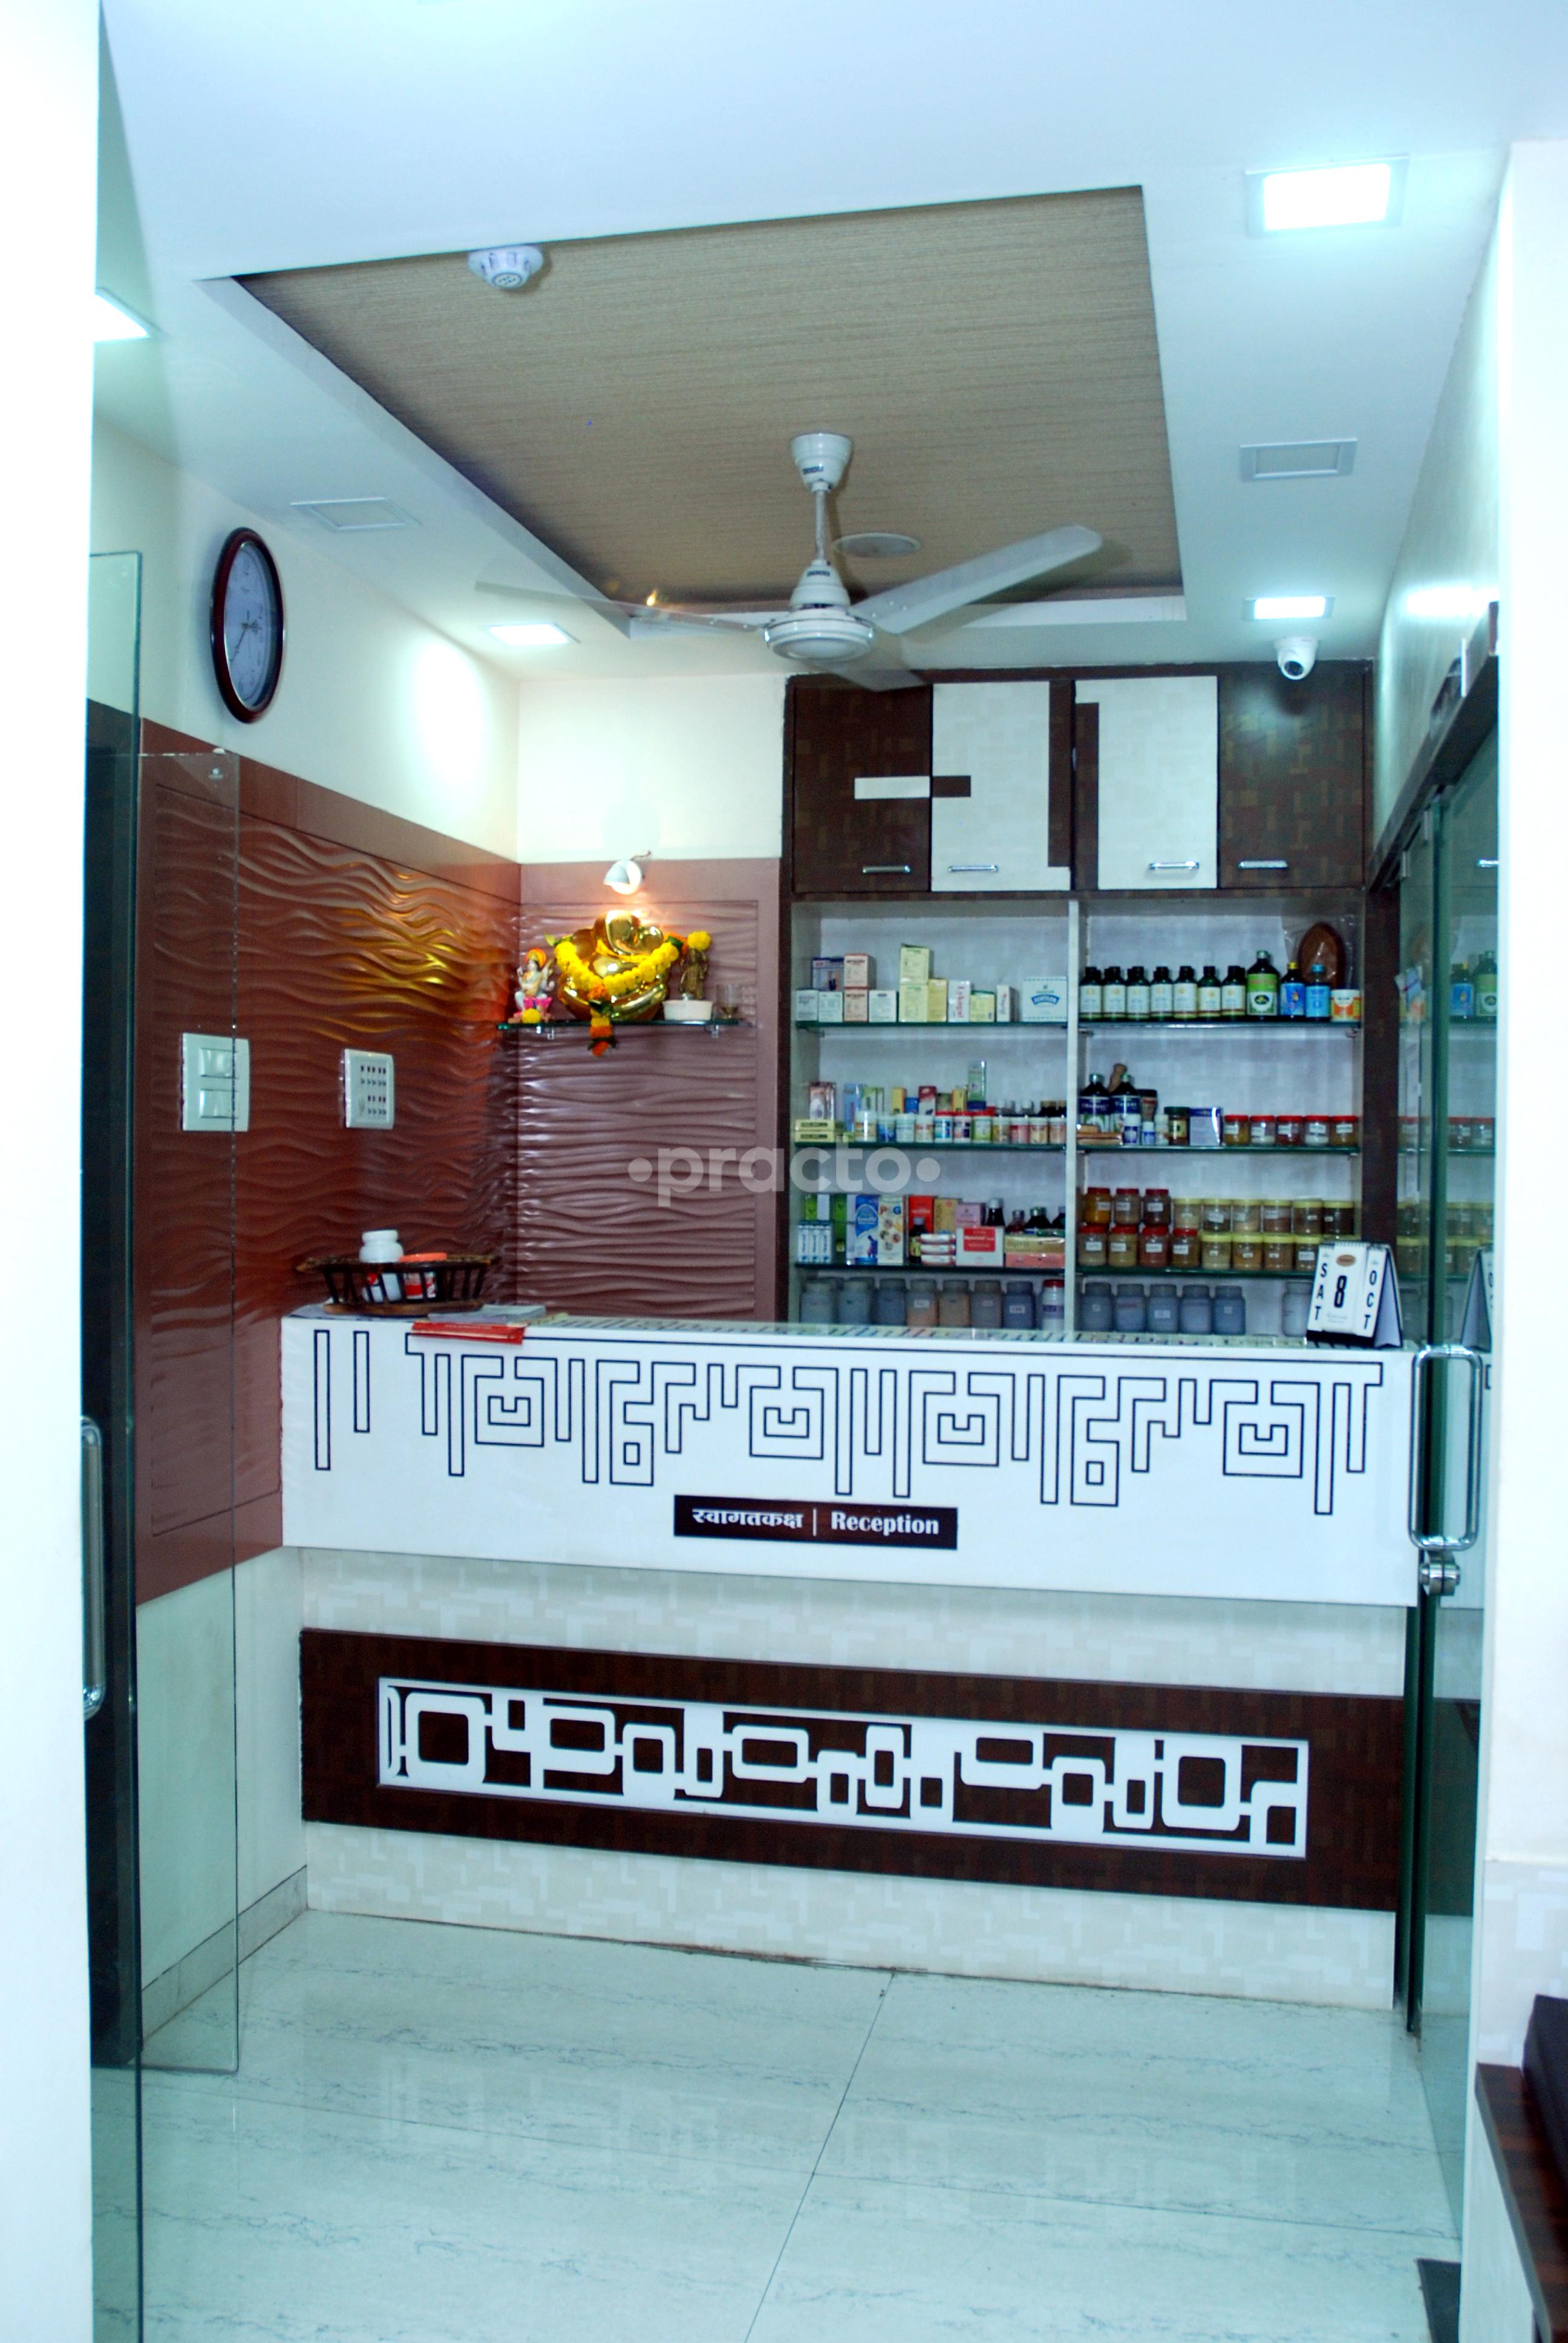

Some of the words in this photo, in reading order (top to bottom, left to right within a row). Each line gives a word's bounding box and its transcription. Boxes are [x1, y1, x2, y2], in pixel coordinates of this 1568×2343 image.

[1334, 1276, 1347, 1308] 8
[691, 1508, 803, 1529] स्वागतकक्ष
[831, 1511, 939, 1536] Reception
